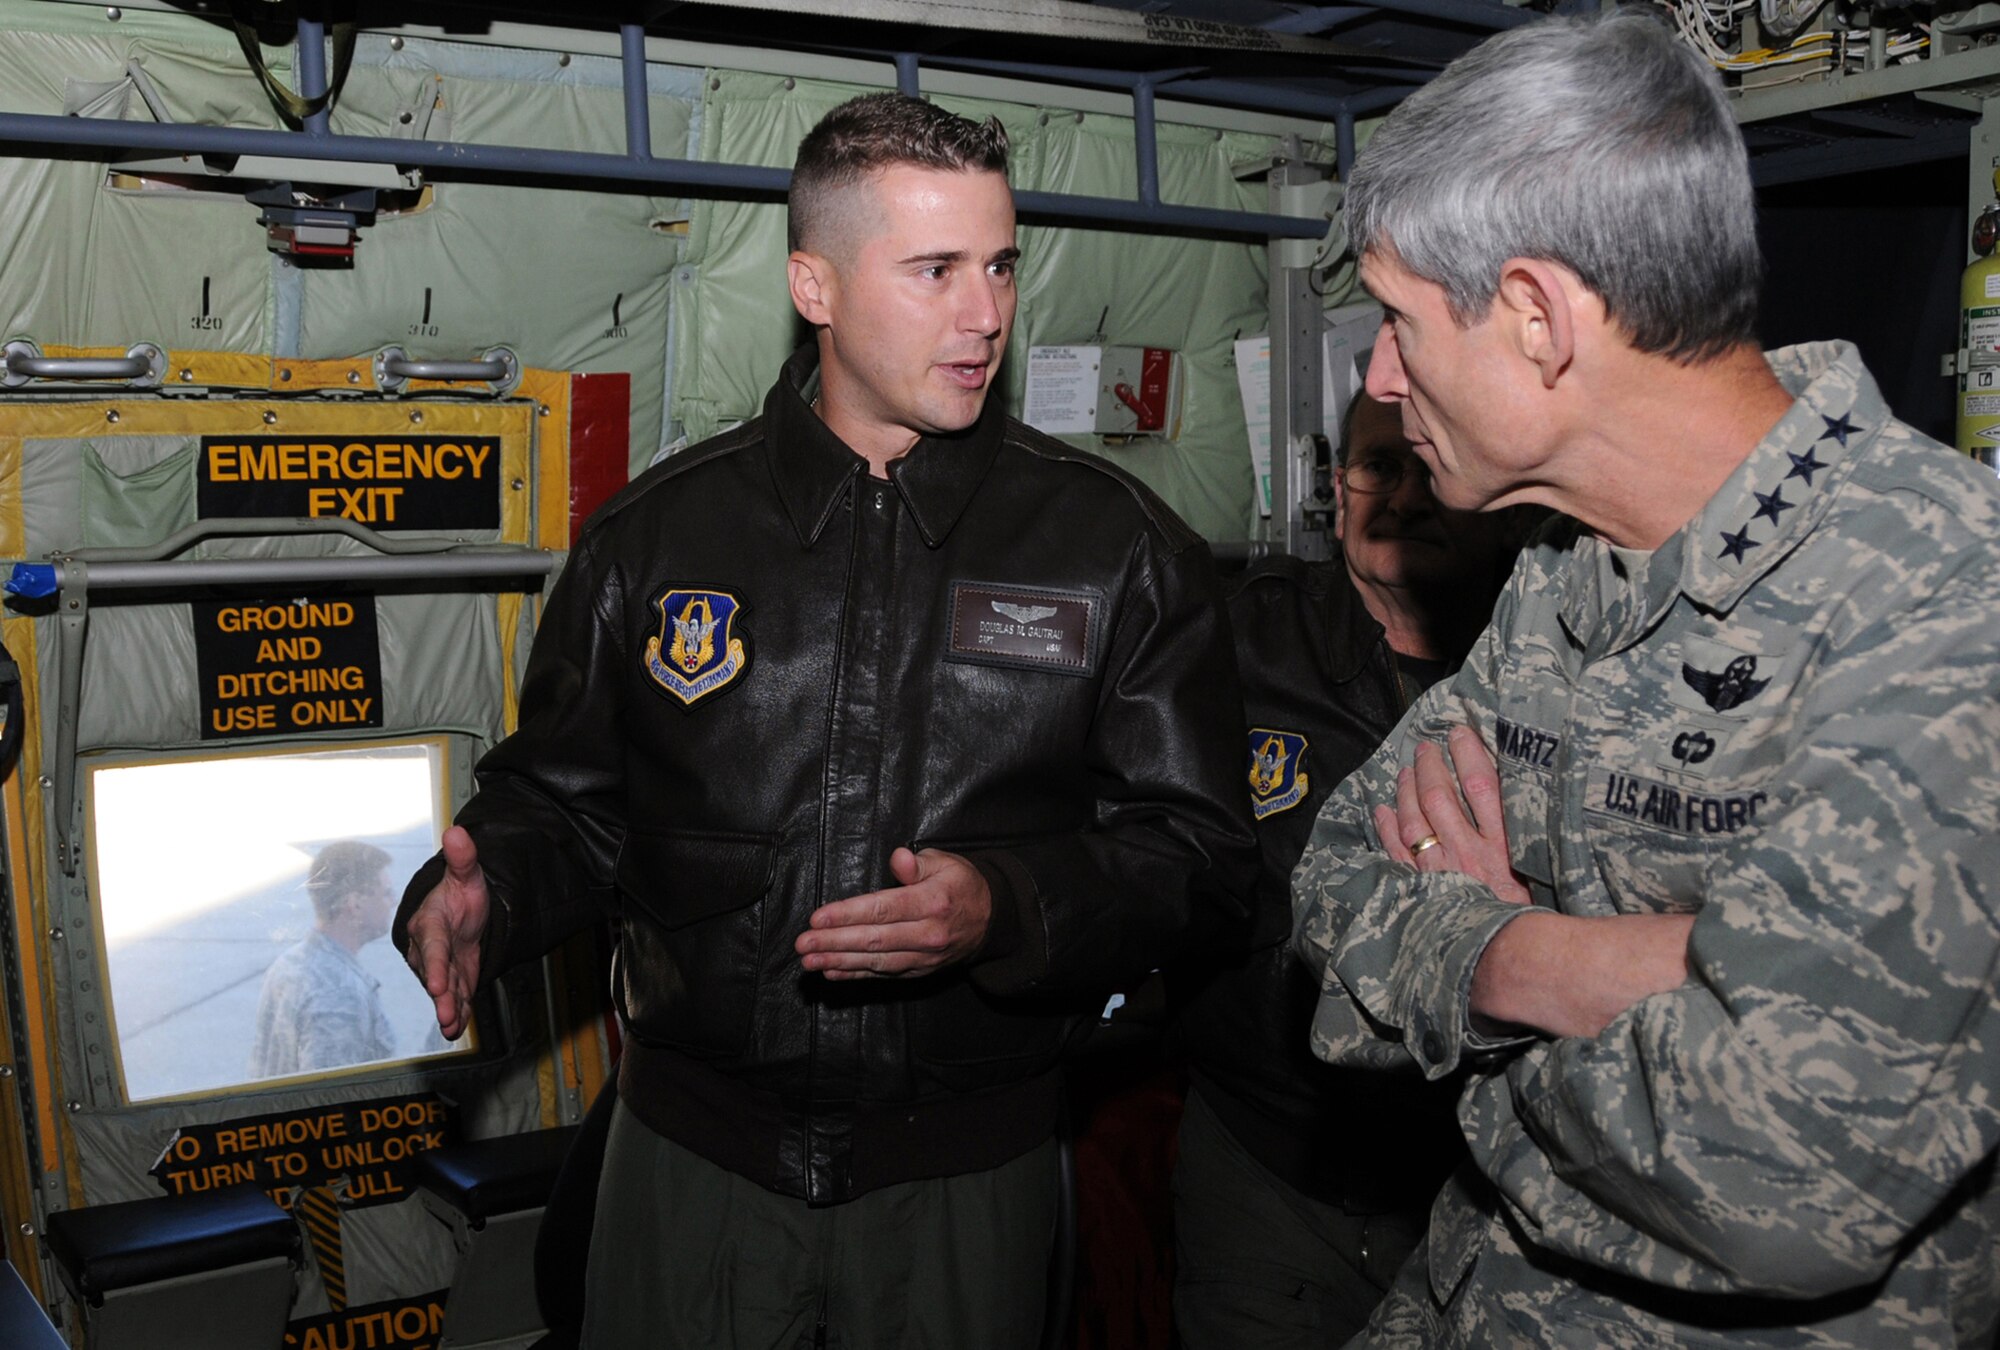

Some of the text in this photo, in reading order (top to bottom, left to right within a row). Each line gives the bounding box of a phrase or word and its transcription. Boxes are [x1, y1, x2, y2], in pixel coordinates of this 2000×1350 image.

[191, 317, 222, 330] 320
[408, 324, 438, 337] 310
[208, 443, 491, 482] EMERGENCY
[308, 487, 404, 522] EXIT
[216, 602, 354, 633] GROUND
[979, 621, 1015, 635] DOUGLAS
[1027, 626, 1064, 641] GAUTRAU
[255, 637, 322, 663] AND
[978, 635, 995, 645] CAPT
[217, 667, 364, 699] DITCHING
[213, 698, 372, 733] USE ONLY
[1605, 773, 1639, 818] U.S.
[1640, 785, 1681, 829] AIR
[215, 1113, 348, 1155] REMOVE
[360, 1101, 447, 1132] DOOR
[167, 1131, 444, 1195] TURN TO UNLOCK
[285, 1302, 445, 1350] AUTION
